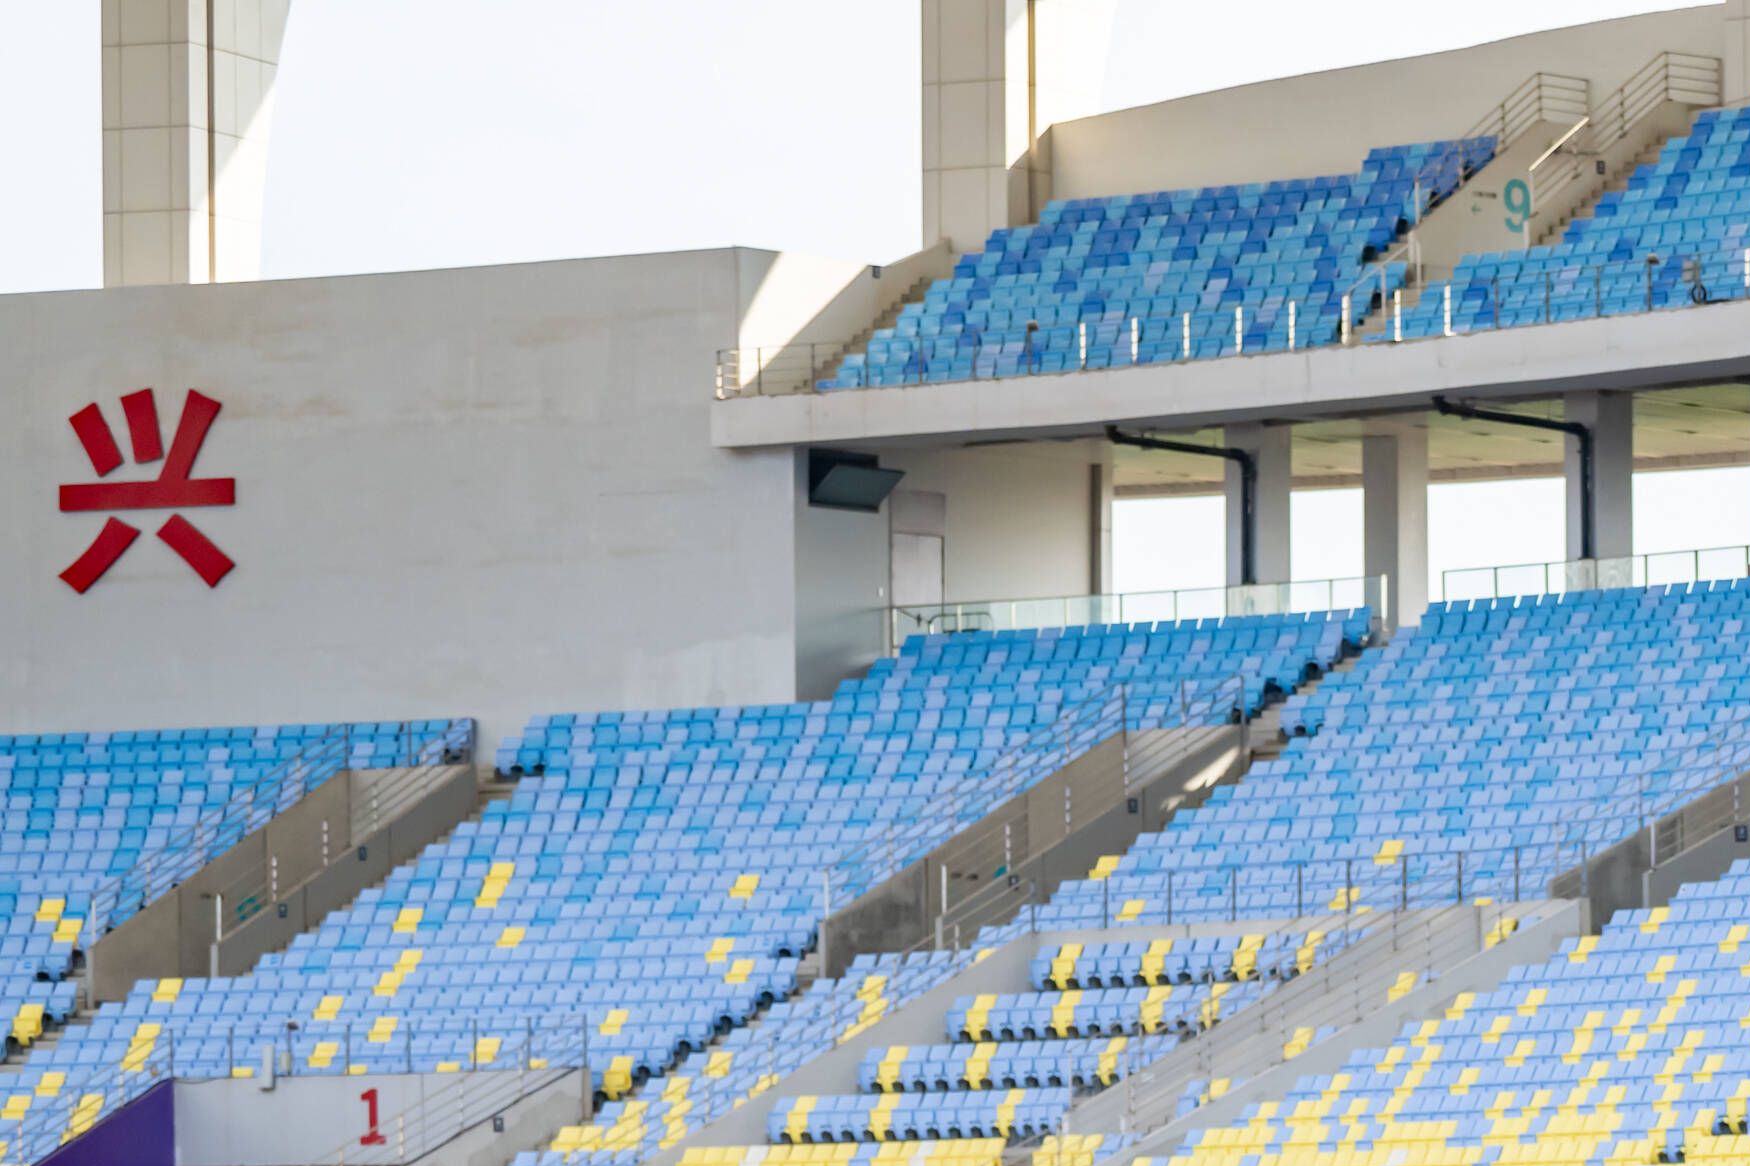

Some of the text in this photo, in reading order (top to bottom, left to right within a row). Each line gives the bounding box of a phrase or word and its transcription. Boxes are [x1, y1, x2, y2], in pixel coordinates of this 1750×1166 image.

[1504, 178, 1530, 234] 9
[58, 388, 236, 594] 兴
[360, 1088, 386, 1145] 1
